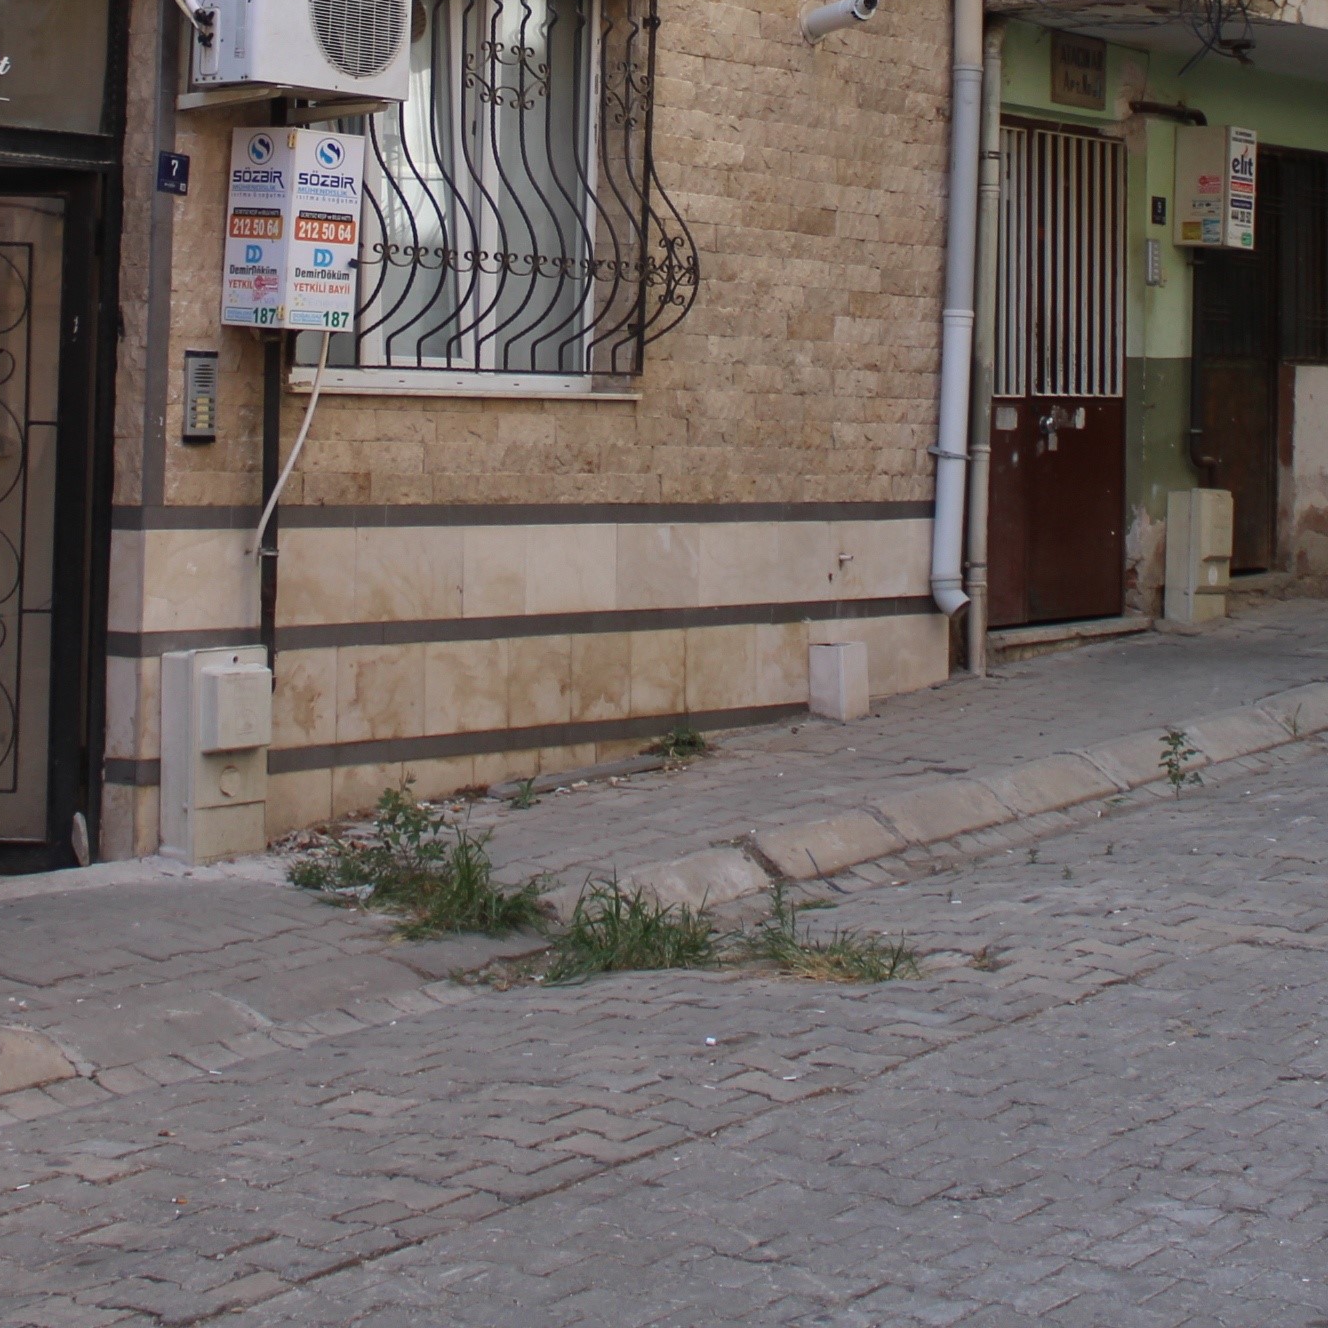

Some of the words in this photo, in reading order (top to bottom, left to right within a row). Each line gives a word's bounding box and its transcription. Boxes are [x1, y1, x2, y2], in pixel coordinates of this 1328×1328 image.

[171, 159, 179, 177] 7
[232, 166, 285, 189] SÖZBİR
[298, 169, 357, 195] SÖZBİR
[232, 217, 251, 234] 212
[253, 218, 265, 235] 50
[267, 219, 279, 236] 64
[299, 221, 319, 240] 212
[322, 223, 336, 240] 50
[338, 224, 352, 242] 64
[295, 267, 350, 281] DemirDöküm
[228, 278, 254, 289] YETKİL
[294, 282, 326, 293] YETKİLİ
[329, 284, 350, 295] BAYİİ
[253, 307, 277, 324] 187
[322, 310, 350, 328] 187
